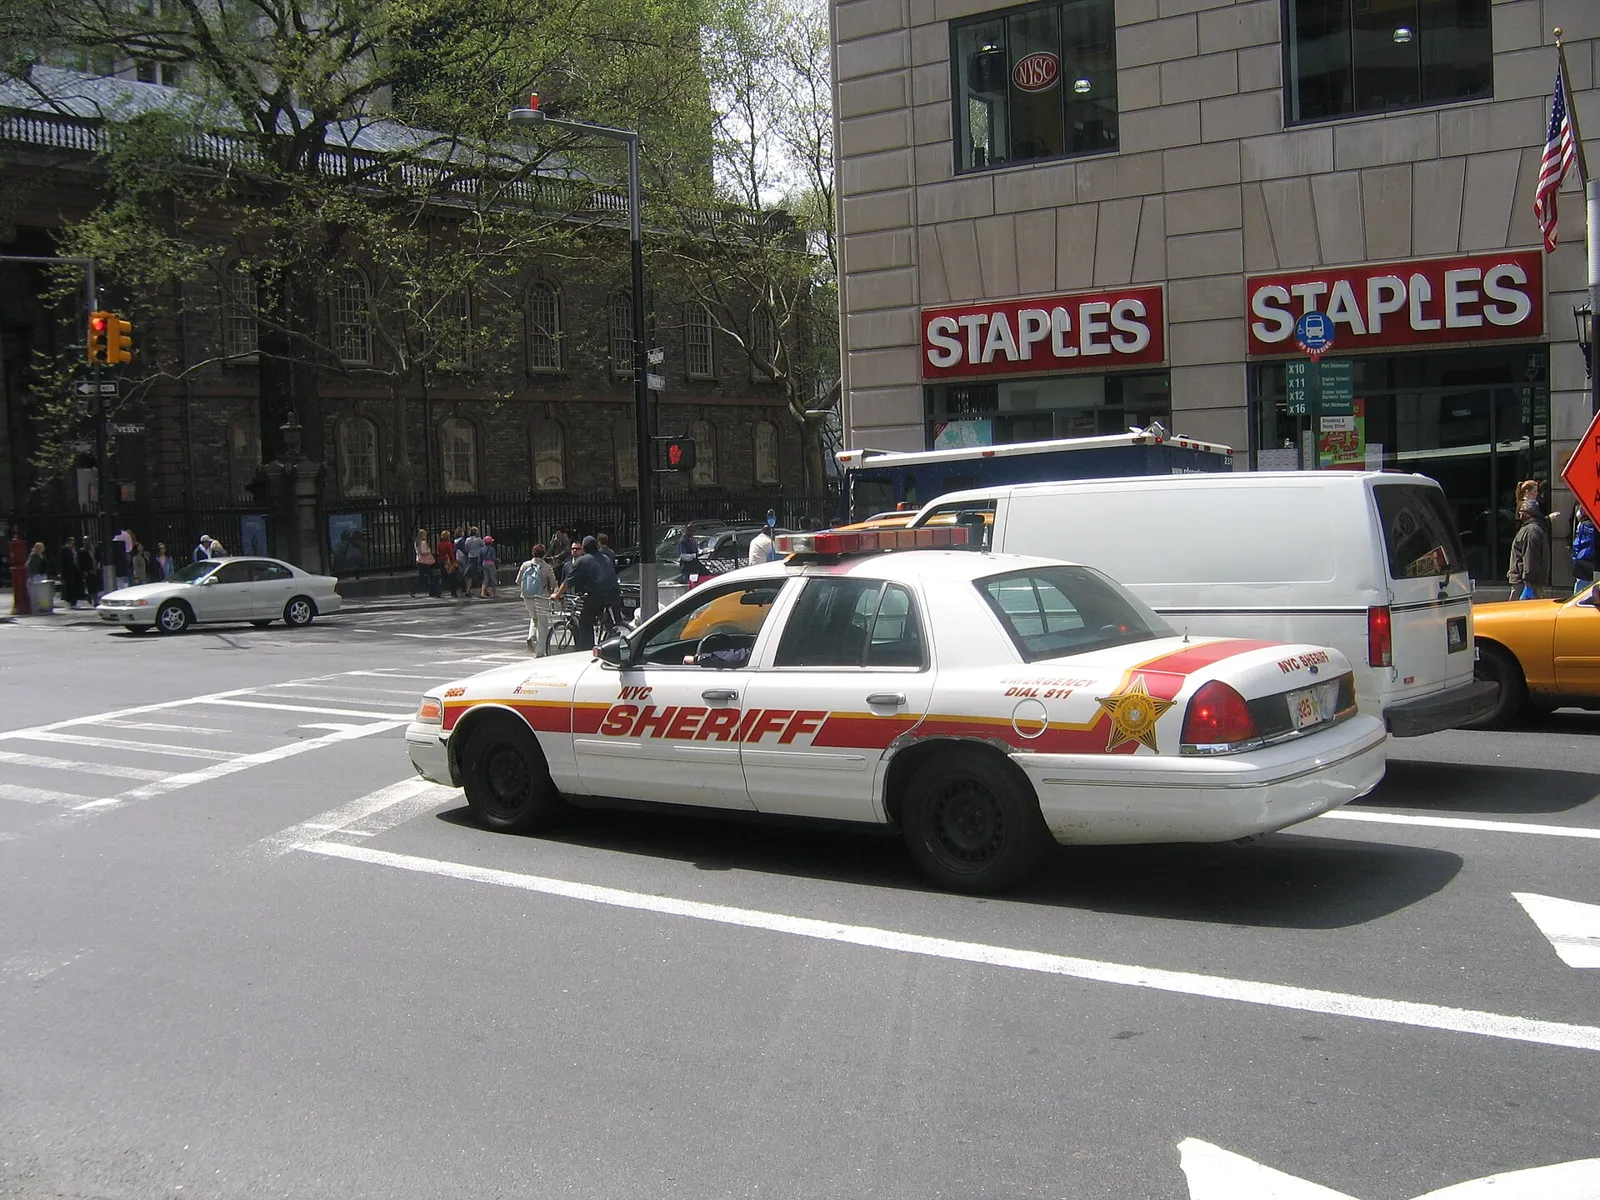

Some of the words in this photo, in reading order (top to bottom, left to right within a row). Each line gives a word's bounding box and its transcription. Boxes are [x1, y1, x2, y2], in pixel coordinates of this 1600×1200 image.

[1020, 58, 1053, 84] NYSC
[1251, 264, 1532, 344] STAPLES
[927, 299, 1151, 368] STAPLES
[1277, 657, 1301, 674] NYC
[1298, 651, 1330, 667] SHERIFF
[617, 686, 653, 700] NYC
[1000, 676, 1098, 688] EMERGENCY
[1004, 686, 1040, 698] DIAL
[1043, 688, 1074, 699] 911
[600, 704, 829, 745] SHERIFF
